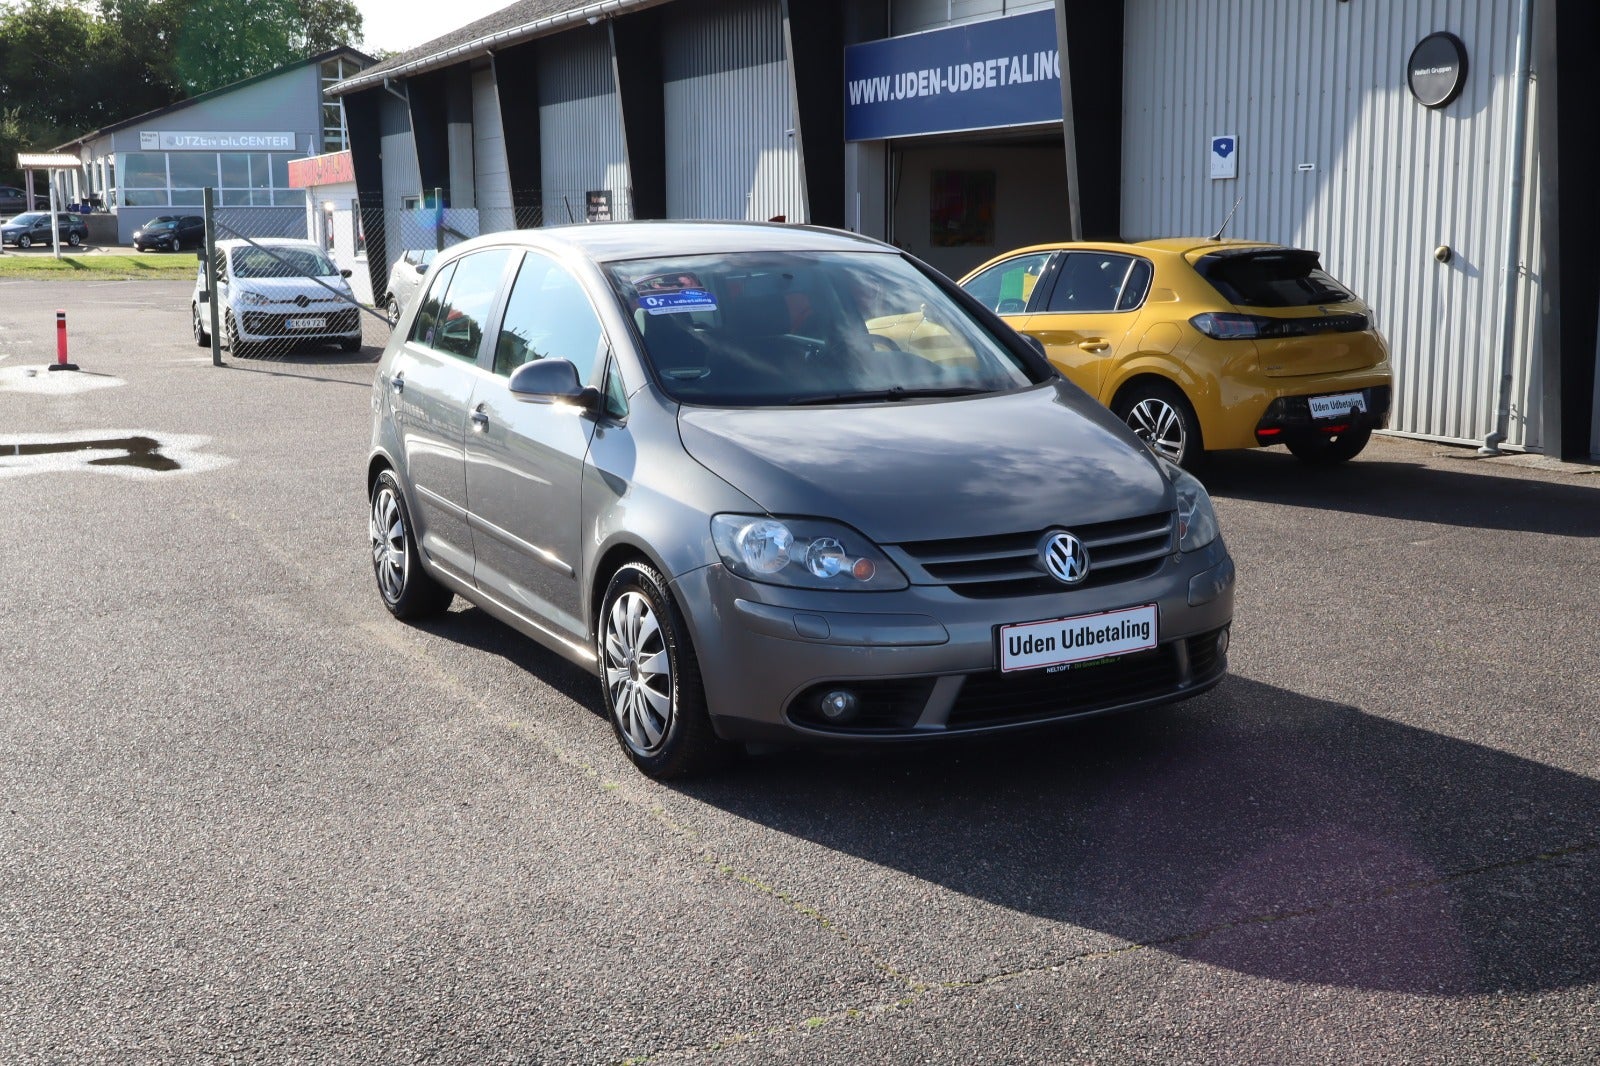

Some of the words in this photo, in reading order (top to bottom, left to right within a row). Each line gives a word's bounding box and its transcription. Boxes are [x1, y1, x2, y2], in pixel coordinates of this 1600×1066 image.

[1431, 66, 1452, 74] Gruppen
[1311, 401, 1330, 412] Uden
[1330, 397, 1364, 410] Udbetaling
[1009, 633, 1056, 657] Uden
[1061, 619, 1151, 650] Udbetaling
[1046, 663, 1071, 674] NELTOFT
